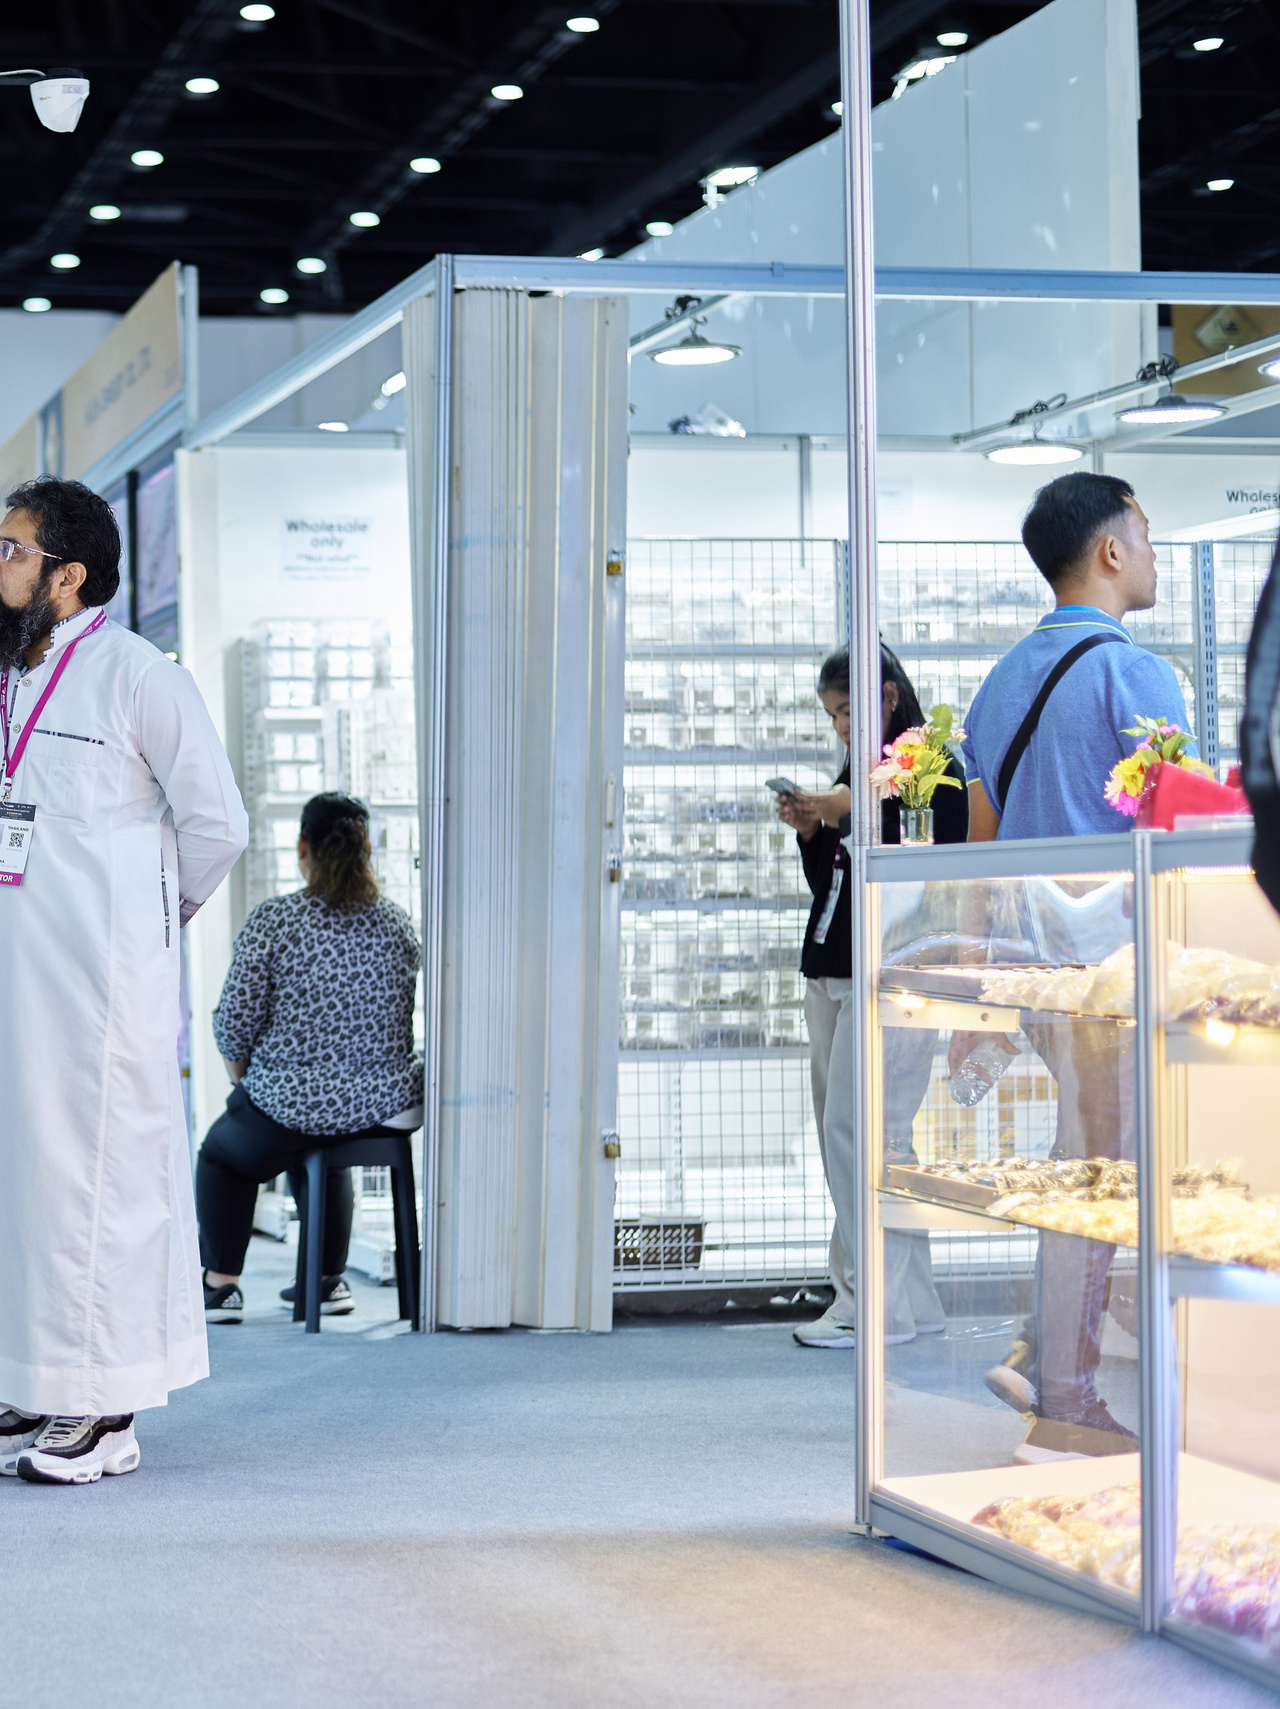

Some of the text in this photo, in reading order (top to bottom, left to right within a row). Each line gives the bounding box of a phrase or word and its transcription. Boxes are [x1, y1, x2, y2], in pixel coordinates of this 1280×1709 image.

[1226, 489, 1279, 502] Wholes
[284, 518, 369, 533] Wholesale
[310, 536, 345, 550] only
